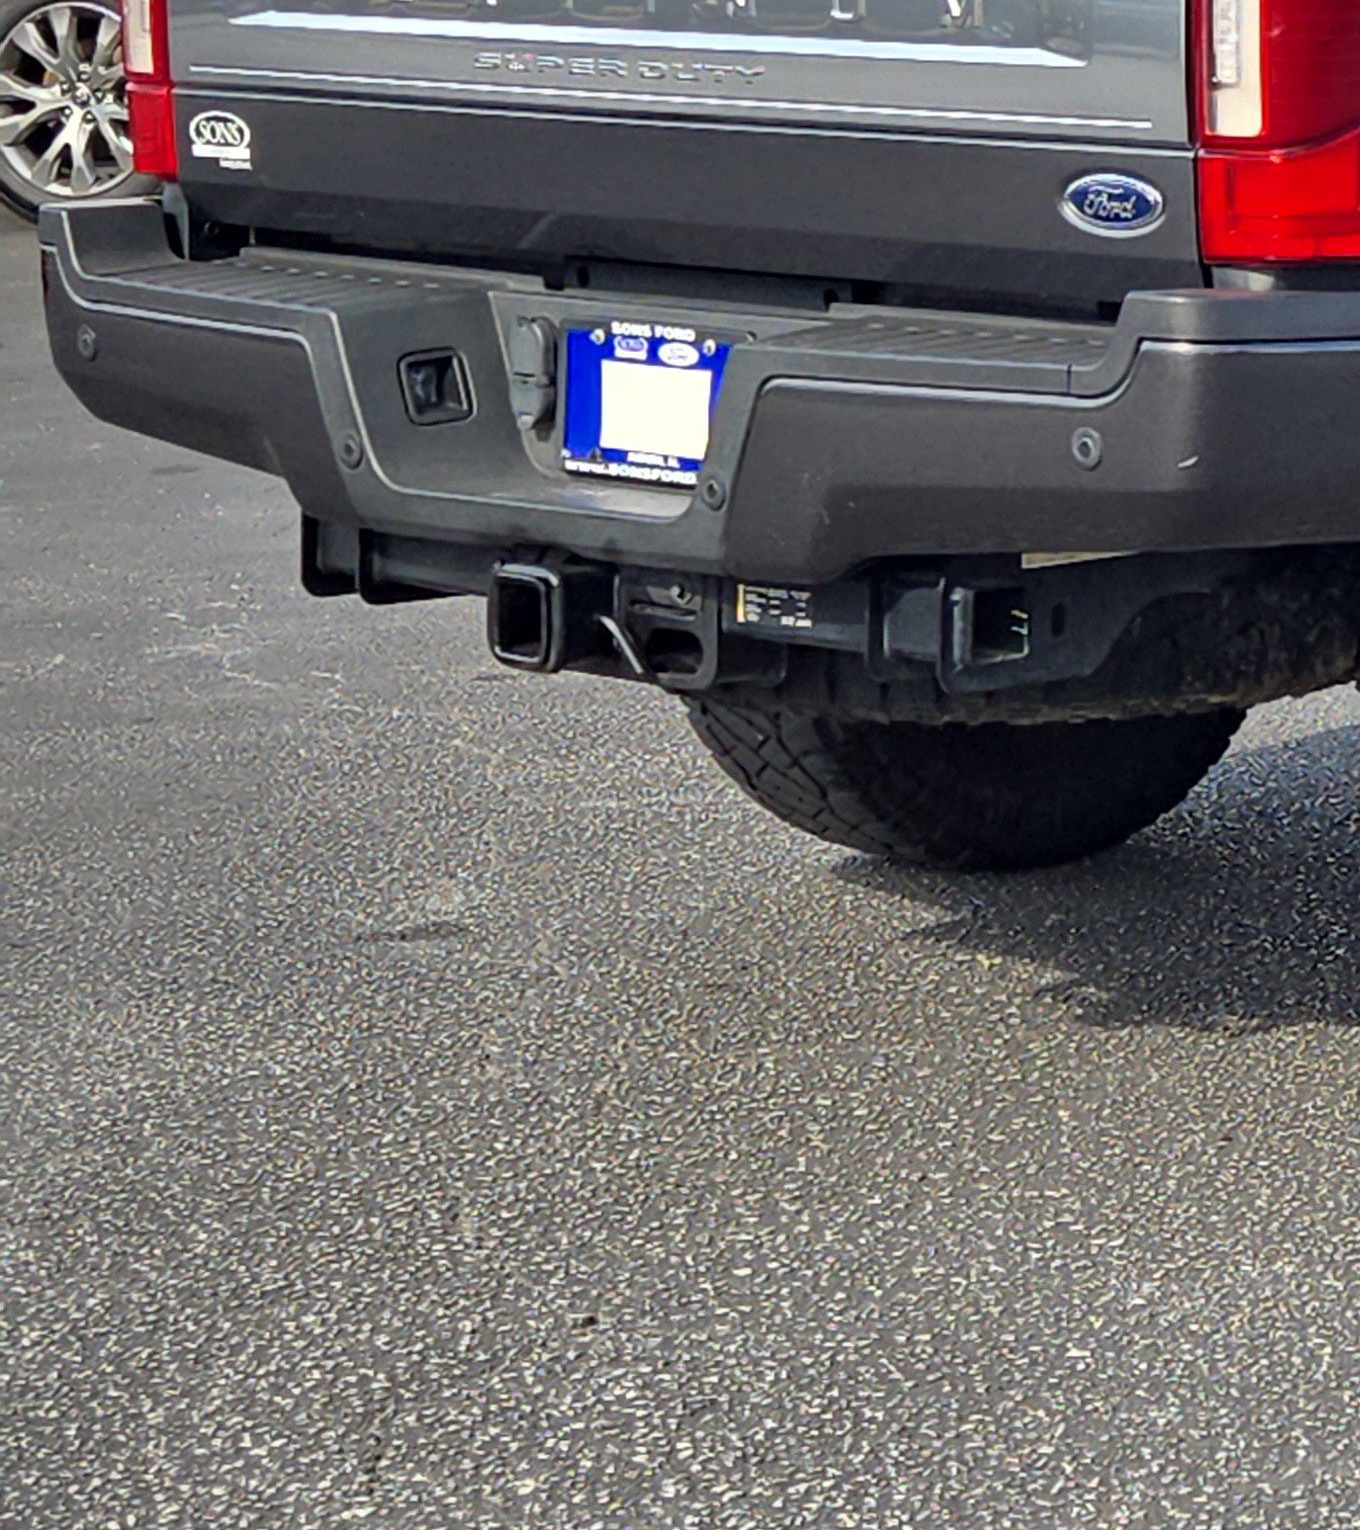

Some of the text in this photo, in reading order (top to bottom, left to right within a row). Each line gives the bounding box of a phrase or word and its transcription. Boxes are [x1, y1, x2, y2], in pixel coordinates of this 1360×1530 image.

[473, 51, 766, 85] SUPER DUTY
[199, 120, 241, 146] SONS
[1083, 185, 1137, 219] Ford
